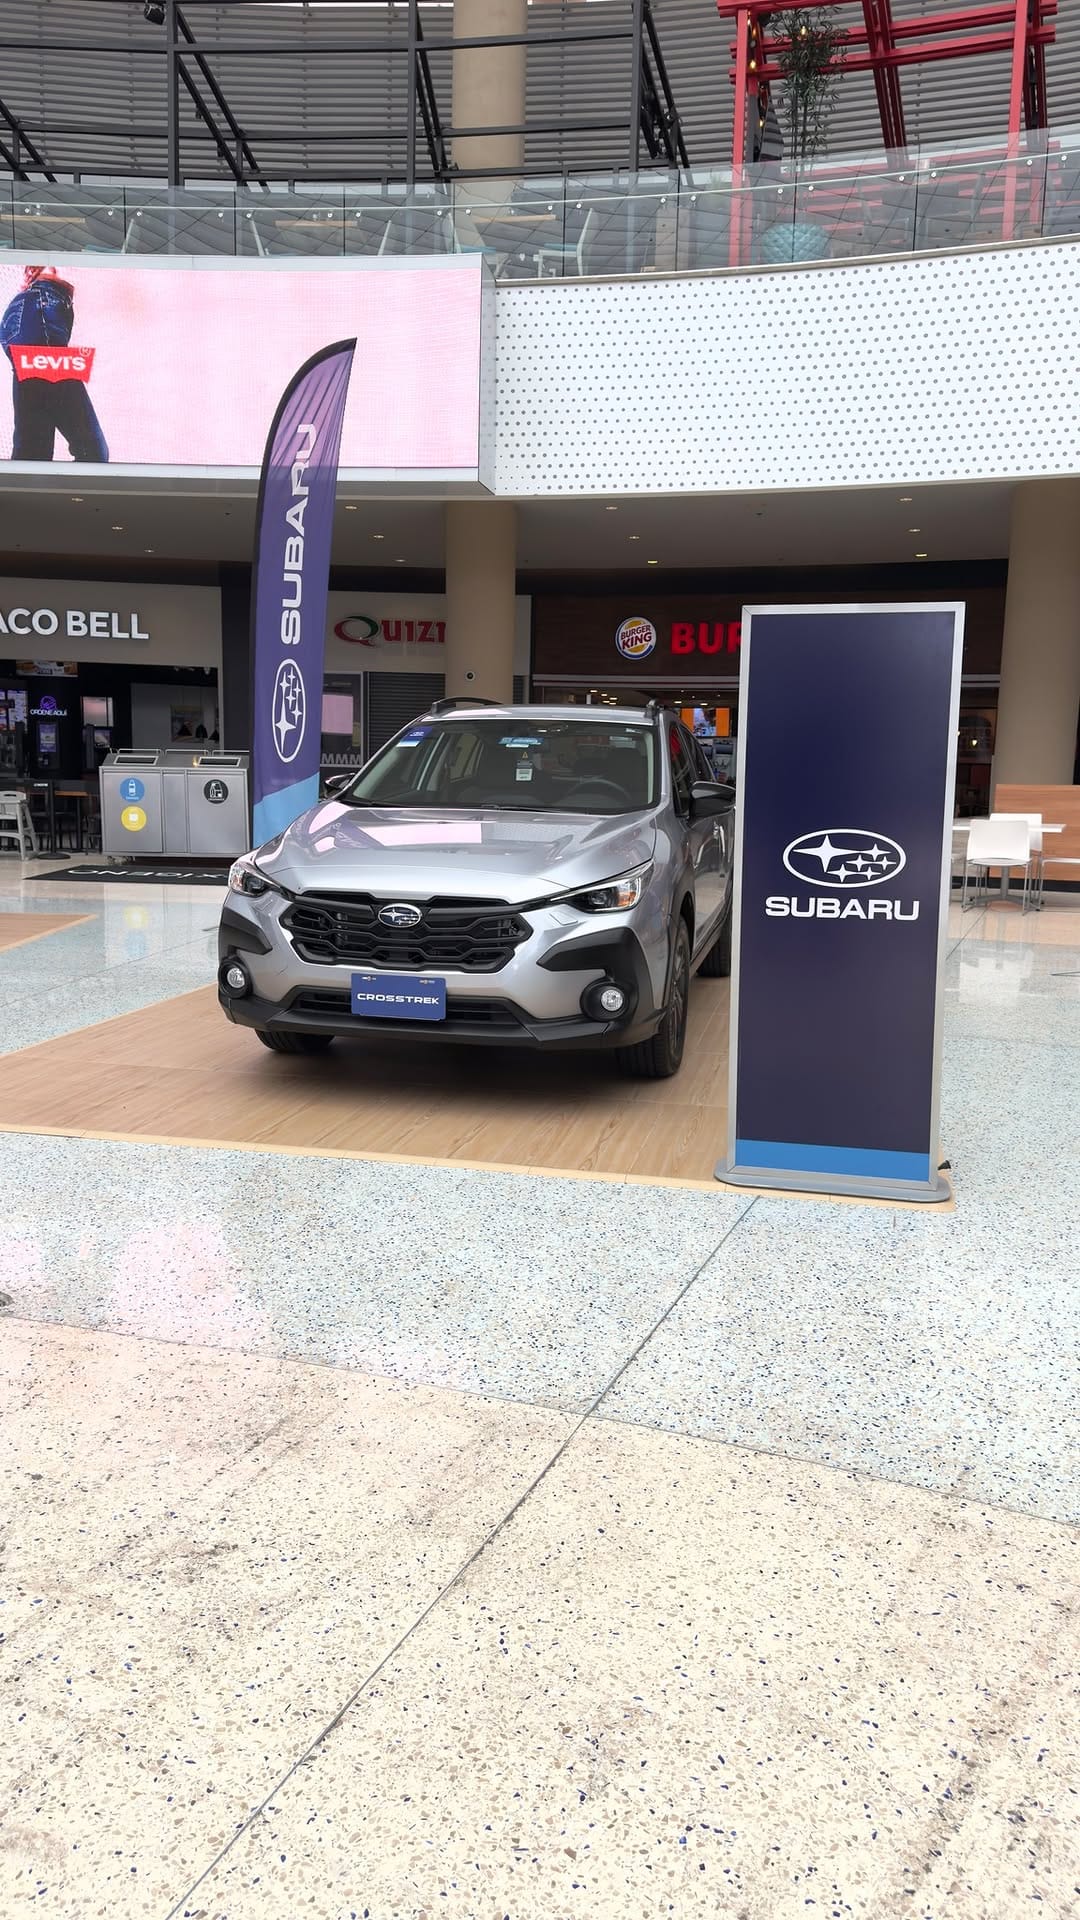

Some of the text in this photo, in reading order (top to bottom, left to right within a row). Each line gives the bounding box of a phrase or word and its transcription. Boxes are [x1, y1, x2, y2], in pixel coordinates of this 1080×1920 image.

[281, 423, 317, 645] SUBARU
[66, 610, 149, 639] BELL
[620, 624, 651, 640] BURGER
[621, 631, 652, 650] KING
[765, 896, 920, 921] SUBARU
[357, 993, 439, 1005] CROSSTREK
